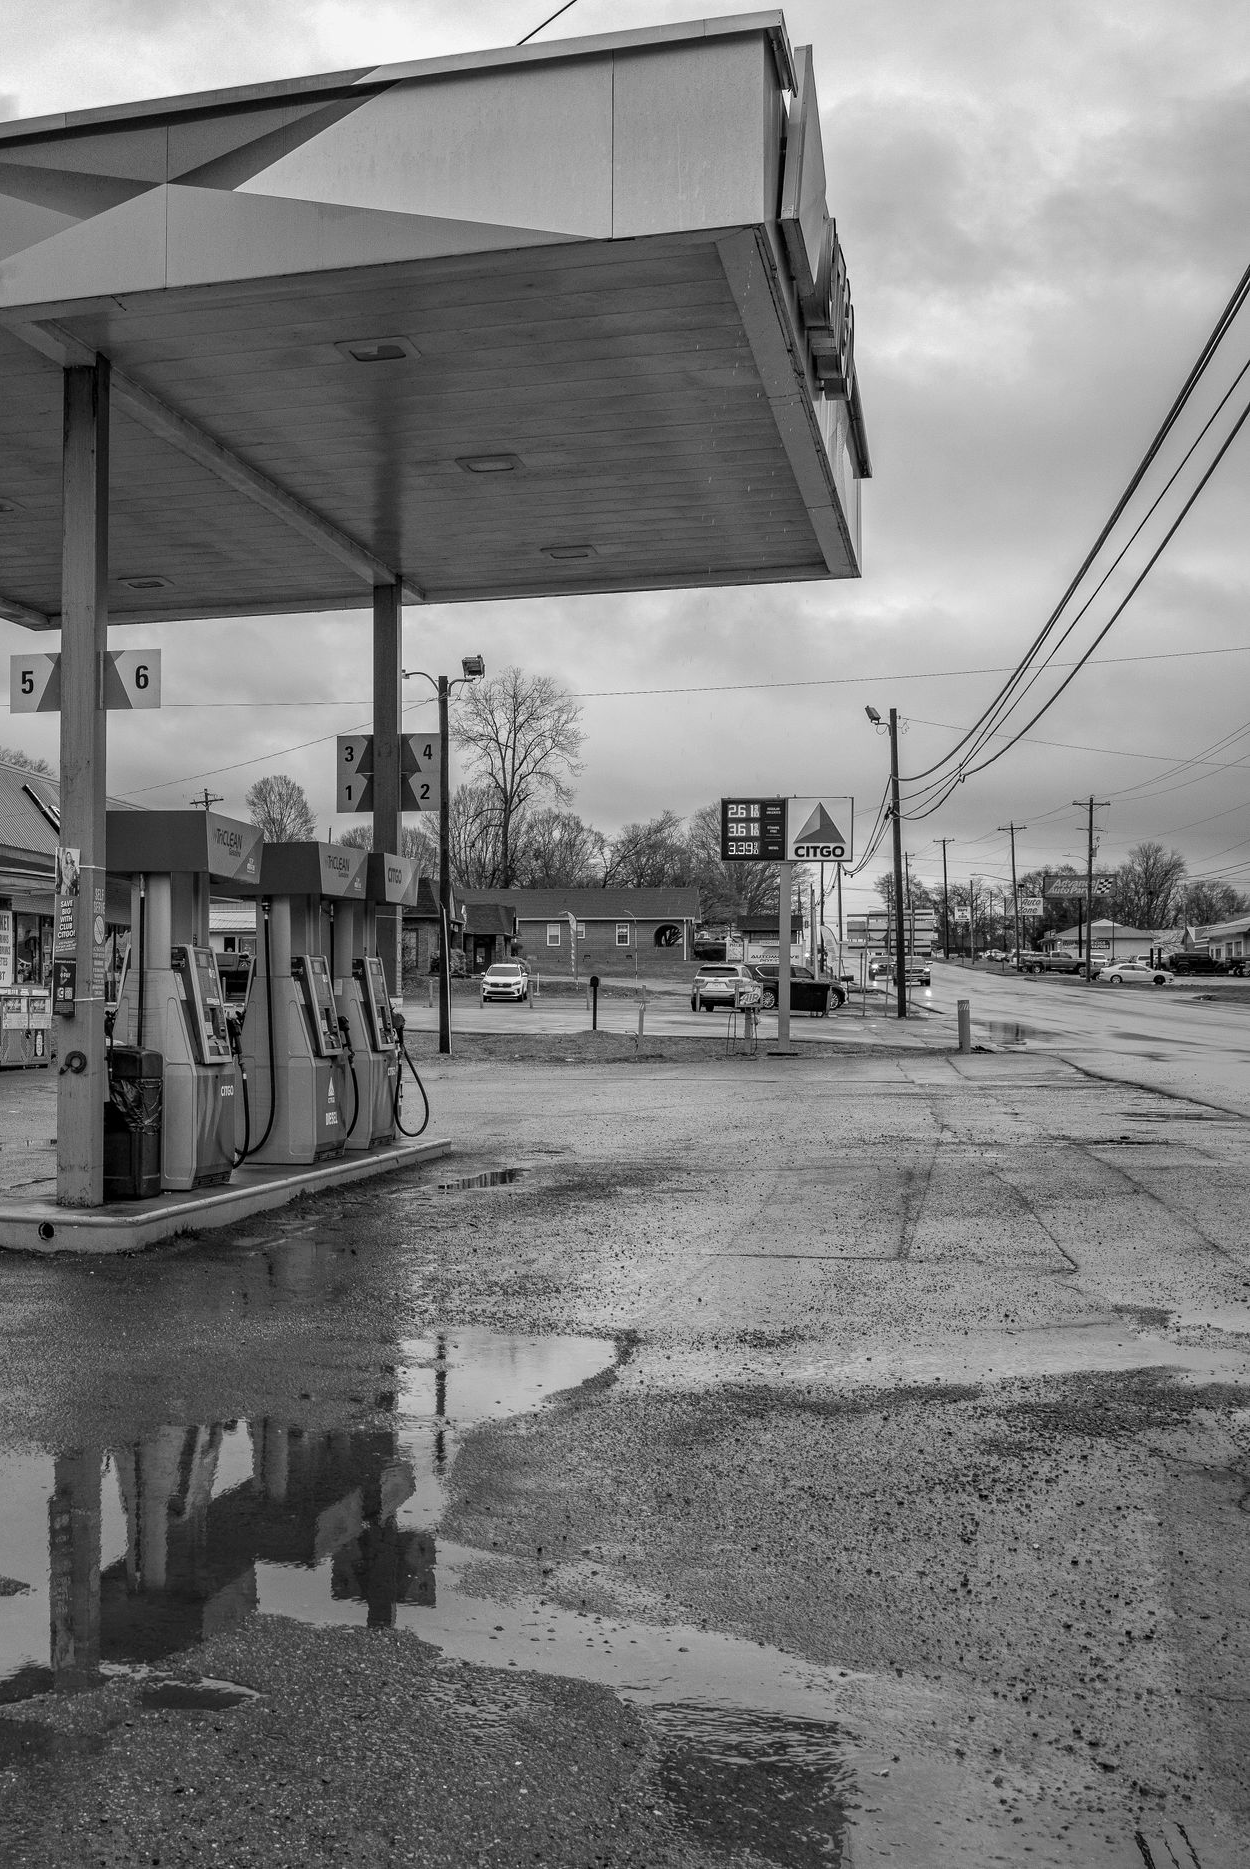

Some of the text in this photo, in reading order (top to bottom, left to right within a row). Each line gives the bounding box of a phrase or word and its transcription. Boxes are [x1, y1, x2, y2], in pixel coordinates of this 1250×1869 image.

[21, 670, 34, 695] 5
[135, 665, 149, 689] 6
[344, 746, 354, 762] 3
[423, 744, 433, 760] 4
[345, 785, 352, 801] 1
[420, 784, 430, 800] 2
[794, 846, 845, 858] CITGO
[387, 867, 403, 884] CITGO
[1053, 879, 1096, 888] Advane
[60, 900, 74, 908] SAVE
[61, 907, 72, 915] BIG
[60, 915, 73, 923] WITH
[59, 922, 73, 931] CLUB
[57, 930, 76, 939] CITGO!
[220, 1085, 234, 1097] CITGO
[325, 1111, 338, 1126] DIESEL
